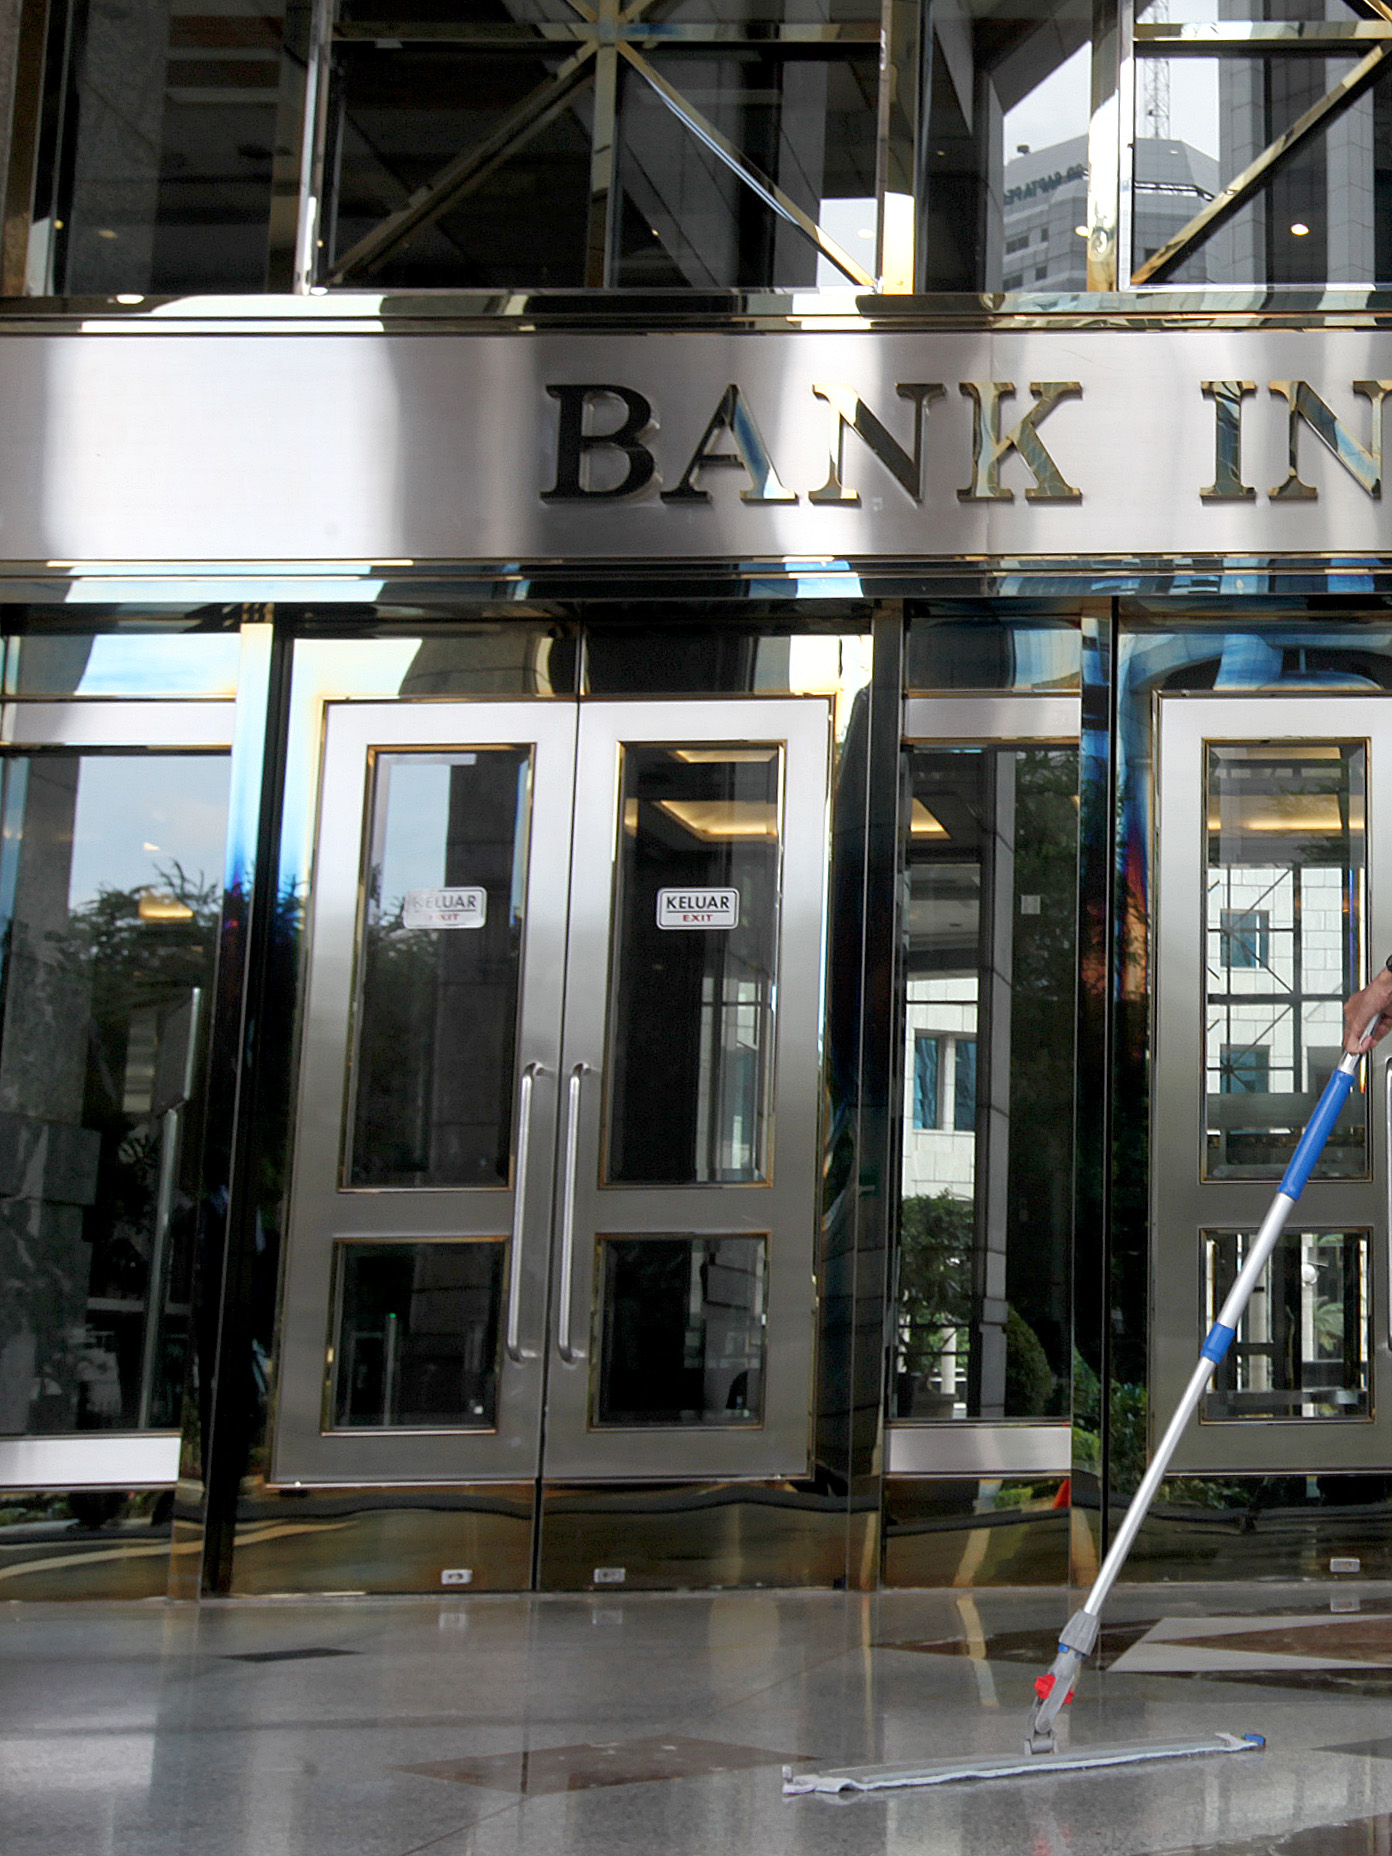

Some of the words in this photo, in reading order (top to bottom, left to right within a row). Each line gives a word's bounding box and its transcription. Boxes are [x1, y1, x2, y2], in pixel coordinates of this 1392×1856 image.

[540, 381, 1083, 504] BANK
[413, 895, 477, 908] KELUAR
[667, 895, 729, 909] KELUAR
[683, 914, 713, 922] EXIT
